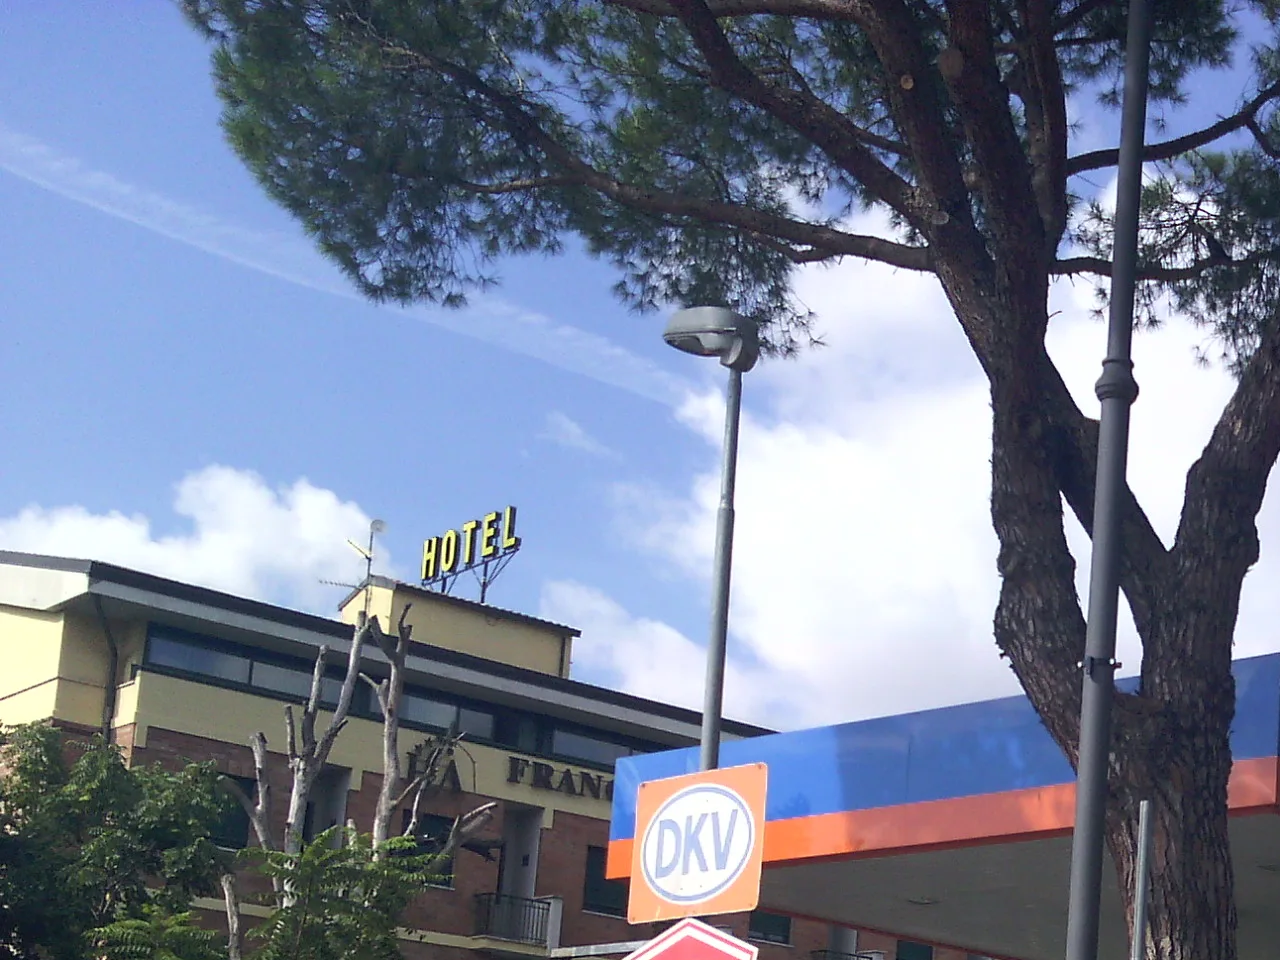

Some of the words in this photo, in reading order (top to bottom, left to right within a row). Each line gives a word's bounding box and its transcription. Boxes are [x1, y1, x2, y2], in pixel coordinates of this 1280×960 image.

[420, 505, 521, 581] HOTEL
[507, 756, 613, 801] FRAN
[654, 808, 739, 880] DKV
